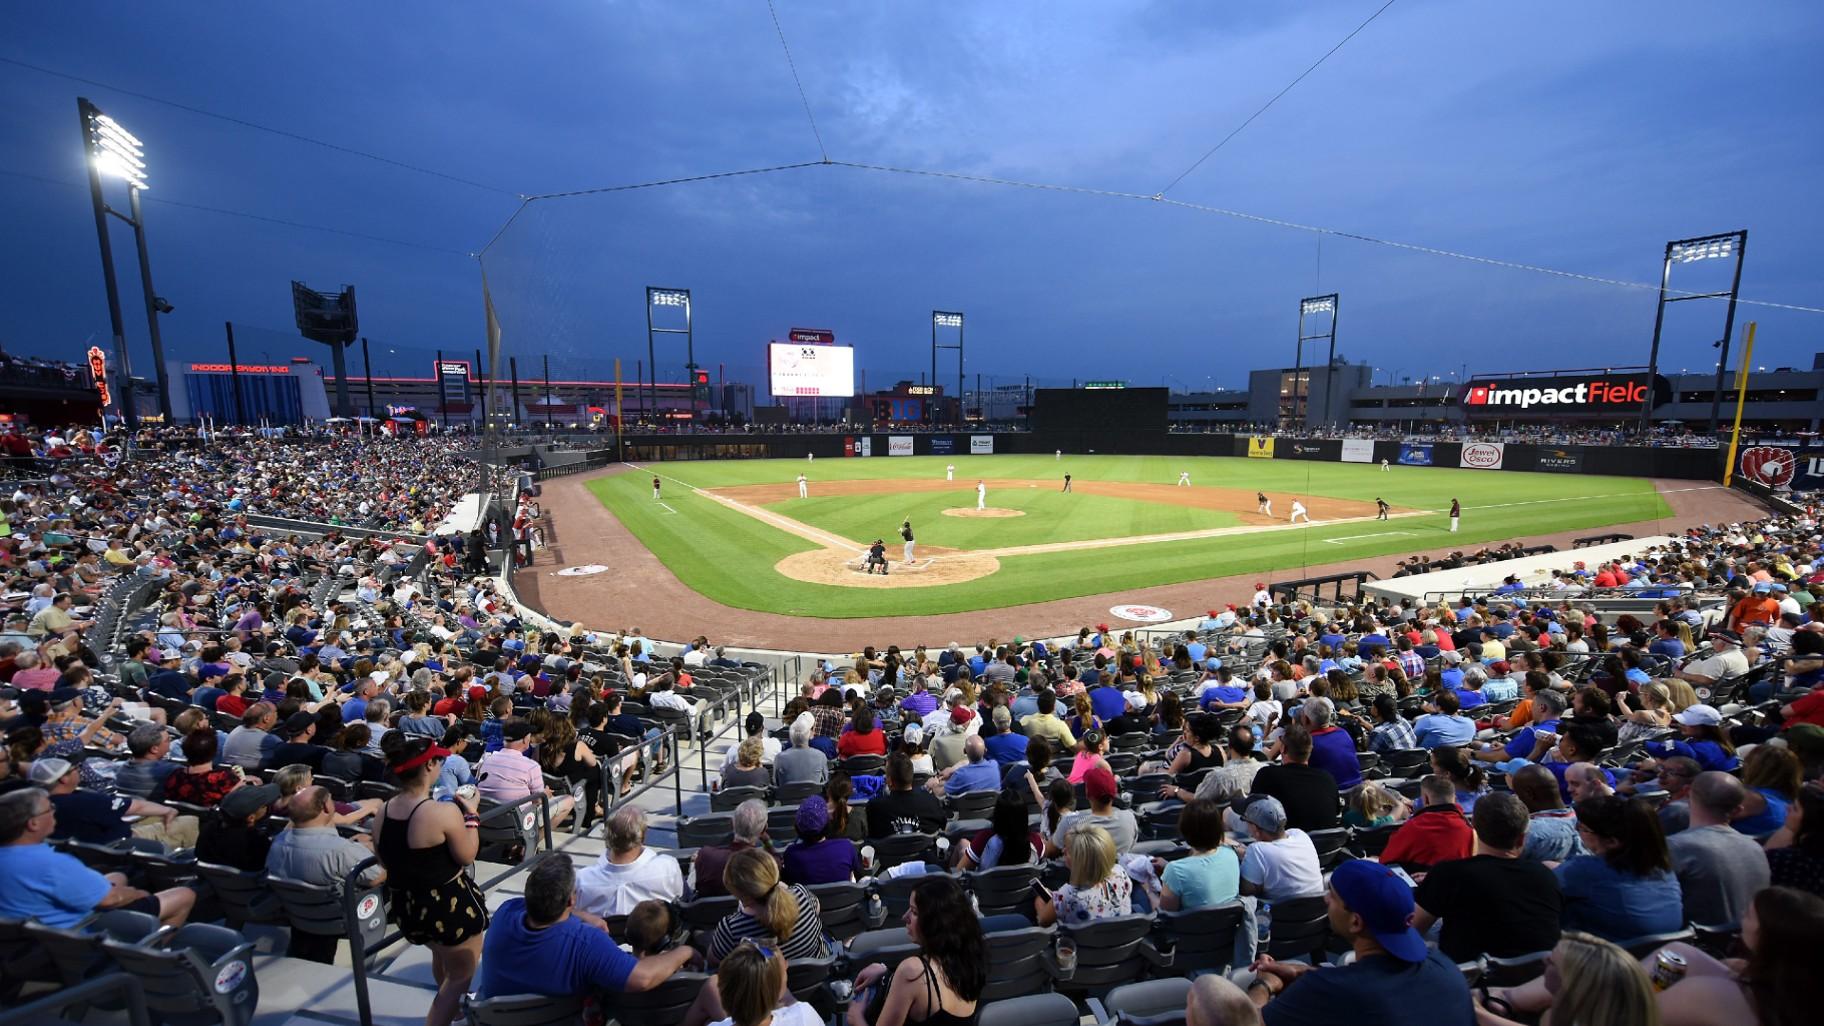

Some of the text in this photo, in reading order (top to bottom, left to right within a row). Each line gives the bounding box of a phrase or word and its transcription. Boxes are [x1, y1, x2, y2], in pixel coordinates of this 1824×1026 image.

[797, 333, 820, 342] impact
[191, 363, 289, 373] INDOOR SKYDIVING
[1468, 448, 1495, 456] Jewel
